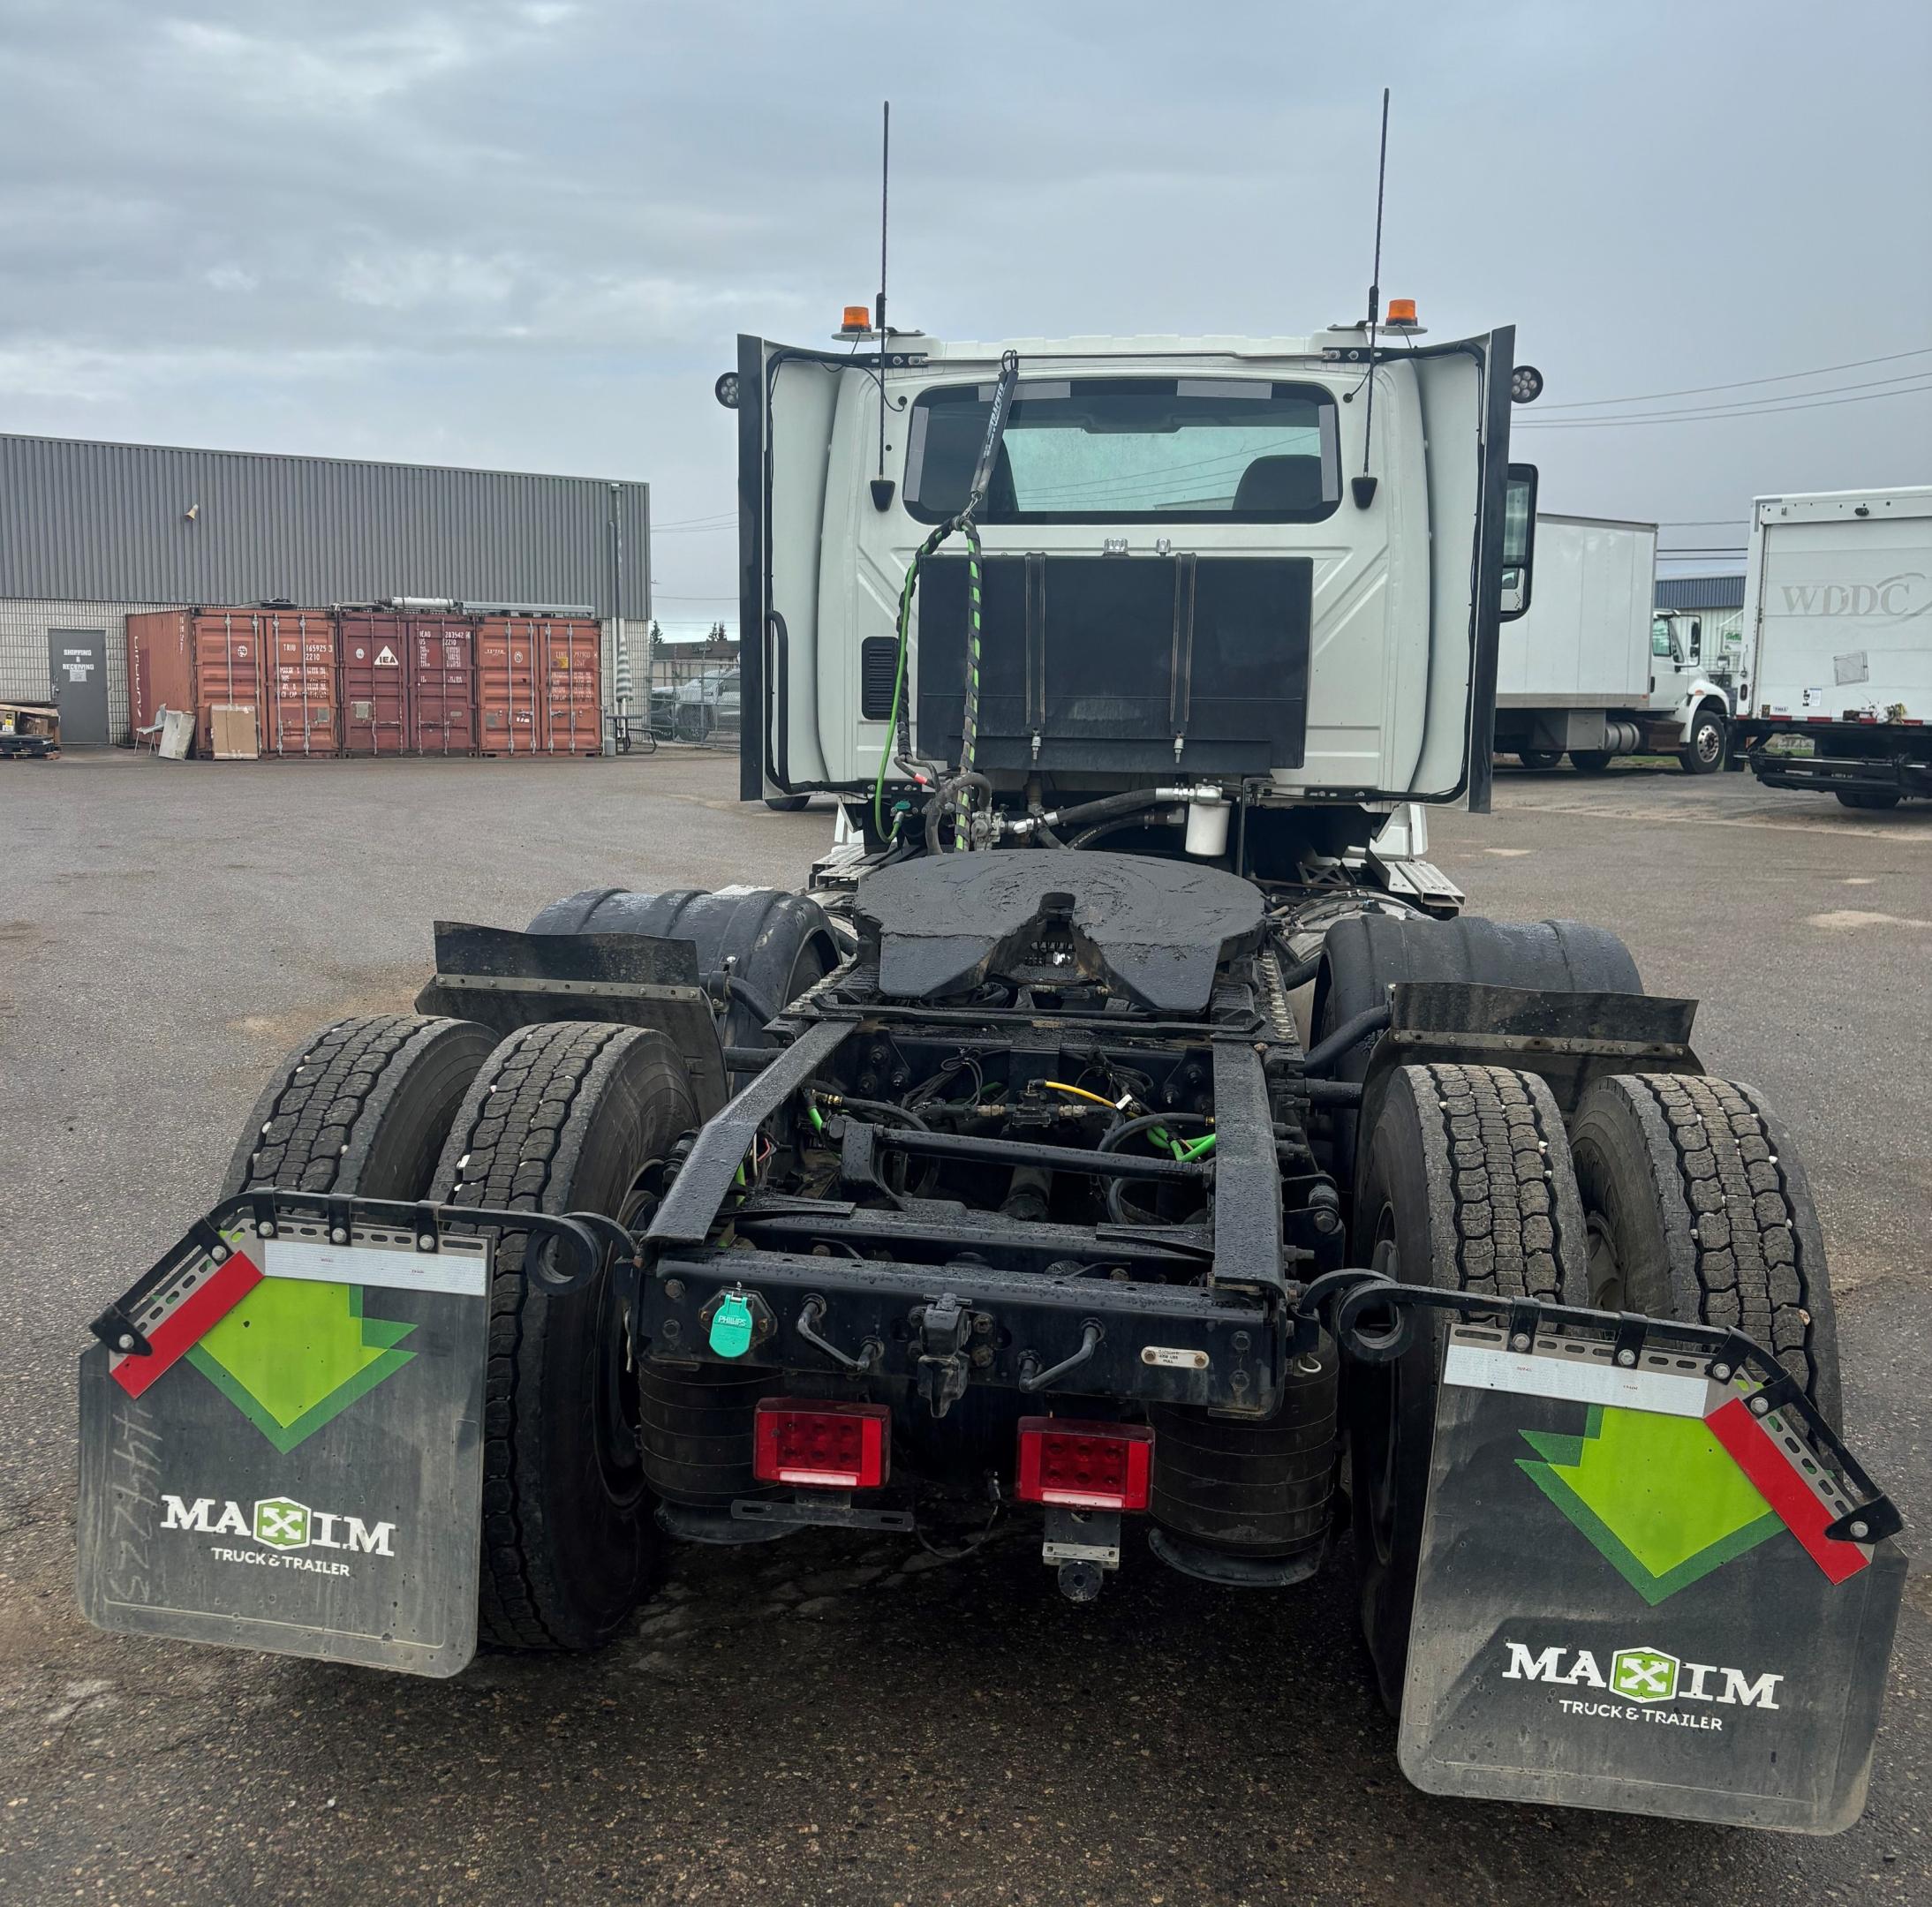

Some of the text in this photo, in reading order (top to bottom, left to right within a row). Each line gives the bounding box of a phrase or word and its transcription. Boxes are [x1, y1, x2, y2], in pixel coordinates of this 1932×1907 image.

[1780, 583, 1910, 616] WDDC
[718, 1315, 747, 1327] PHILLIPS
[160, 1495, 396, 1557] MAXIM
[211, 1547, 351, 1578] TRUCK & TRAILER
[1502, 1642, 1785, 1710] MAXIM
[1559, 1700, 1723, 1731] TRUCK & TRAILER
